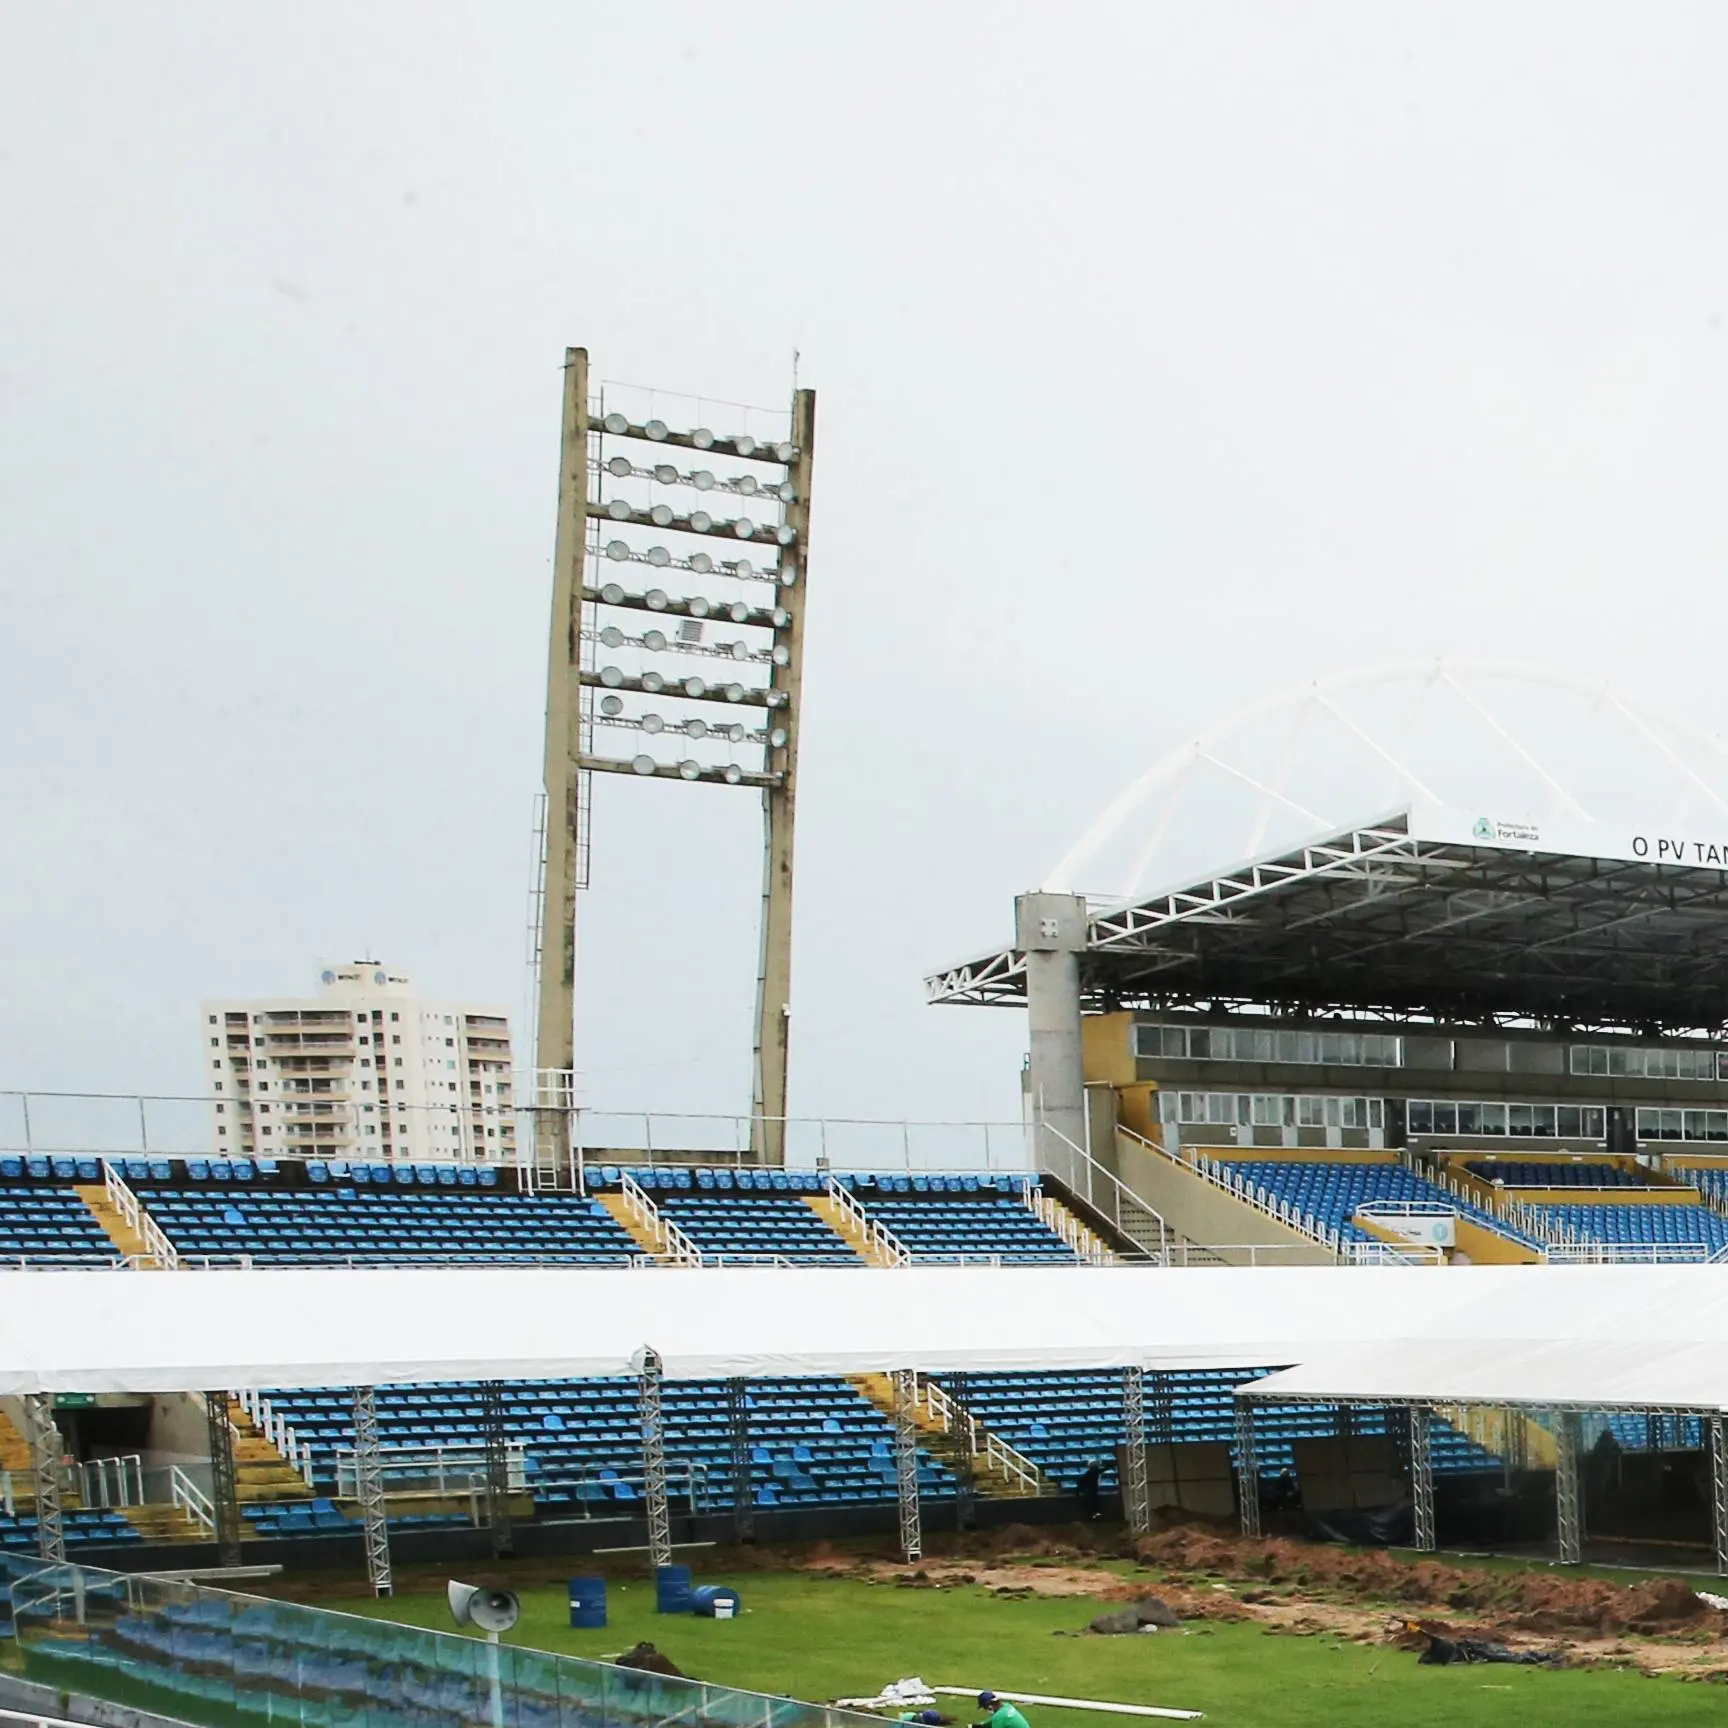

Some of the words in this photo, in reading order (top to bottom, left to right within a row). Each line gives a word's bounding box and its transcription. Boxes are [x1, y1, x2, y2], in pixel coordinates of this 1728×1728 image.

[1497, 829, 1539, 841] Fortaleza
[1632, 836, 1648, 856] O
[1658, 839, 1685, 860] PV
